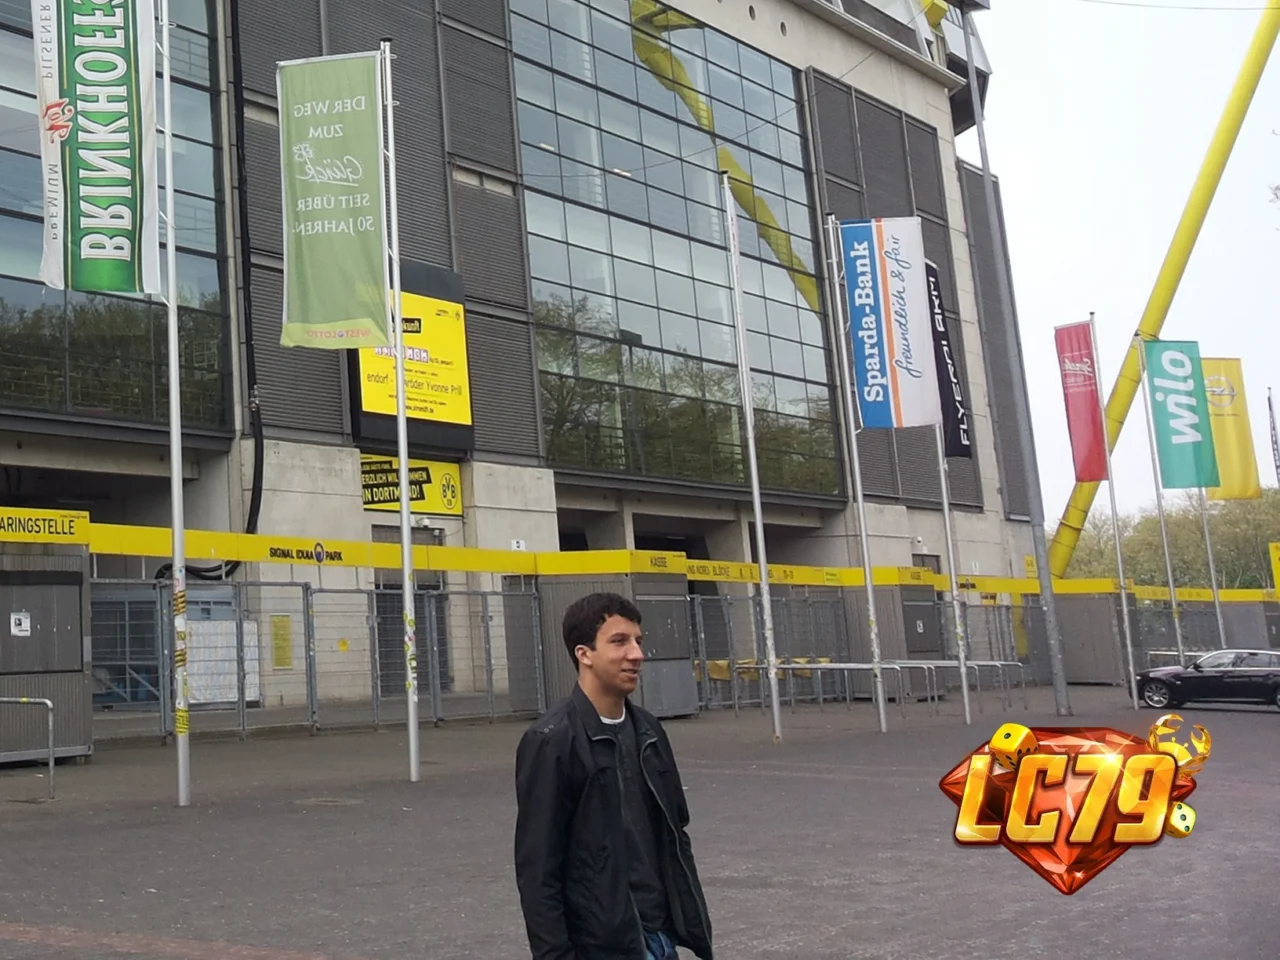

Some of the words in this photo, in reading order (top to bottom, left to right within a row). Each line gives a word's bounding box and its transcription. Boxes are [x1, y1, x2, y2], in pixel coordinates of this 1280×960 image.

[883, 234, 912, 270] fair
[850, 240, 889, 403] Sparda-Bank
[891, 288, 922, 379] freundlich
[1153, 349, 1203, 445] wilo
[361, 472, 386, 485] ERZLICH
[269, 546, 295, 560] SIGNAL
[325, 550, 344, 561] PARK
